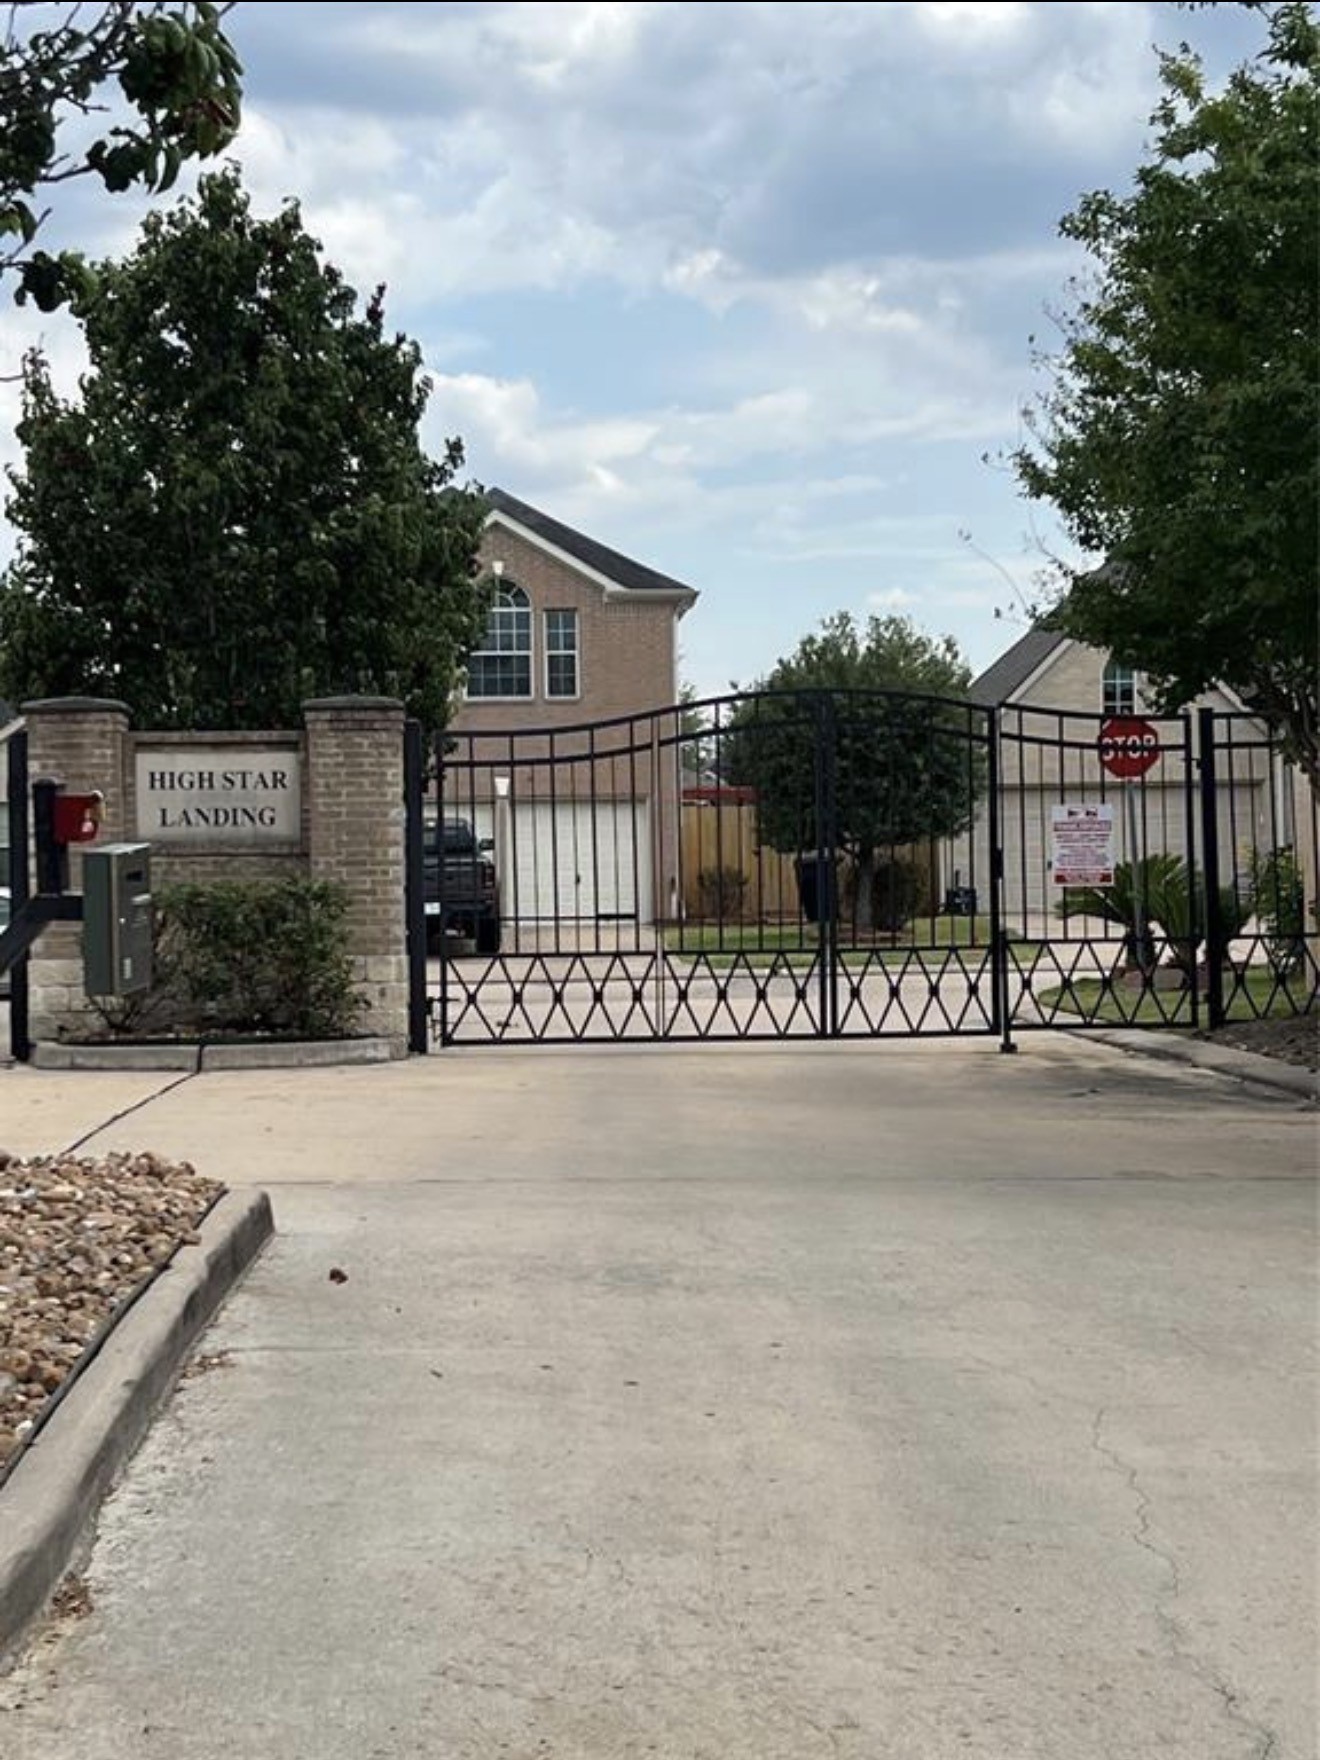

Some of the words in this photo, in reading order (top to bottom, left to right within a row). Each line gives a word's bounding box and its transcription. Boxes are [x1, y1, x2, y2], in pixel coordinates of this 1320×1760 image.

[1102, 735, 1156, 761] STOP
[148, 771, 215, 791] HIGH
[221, 771, 288, 791] STAR
[159, 807, 277, 828] LANDING
